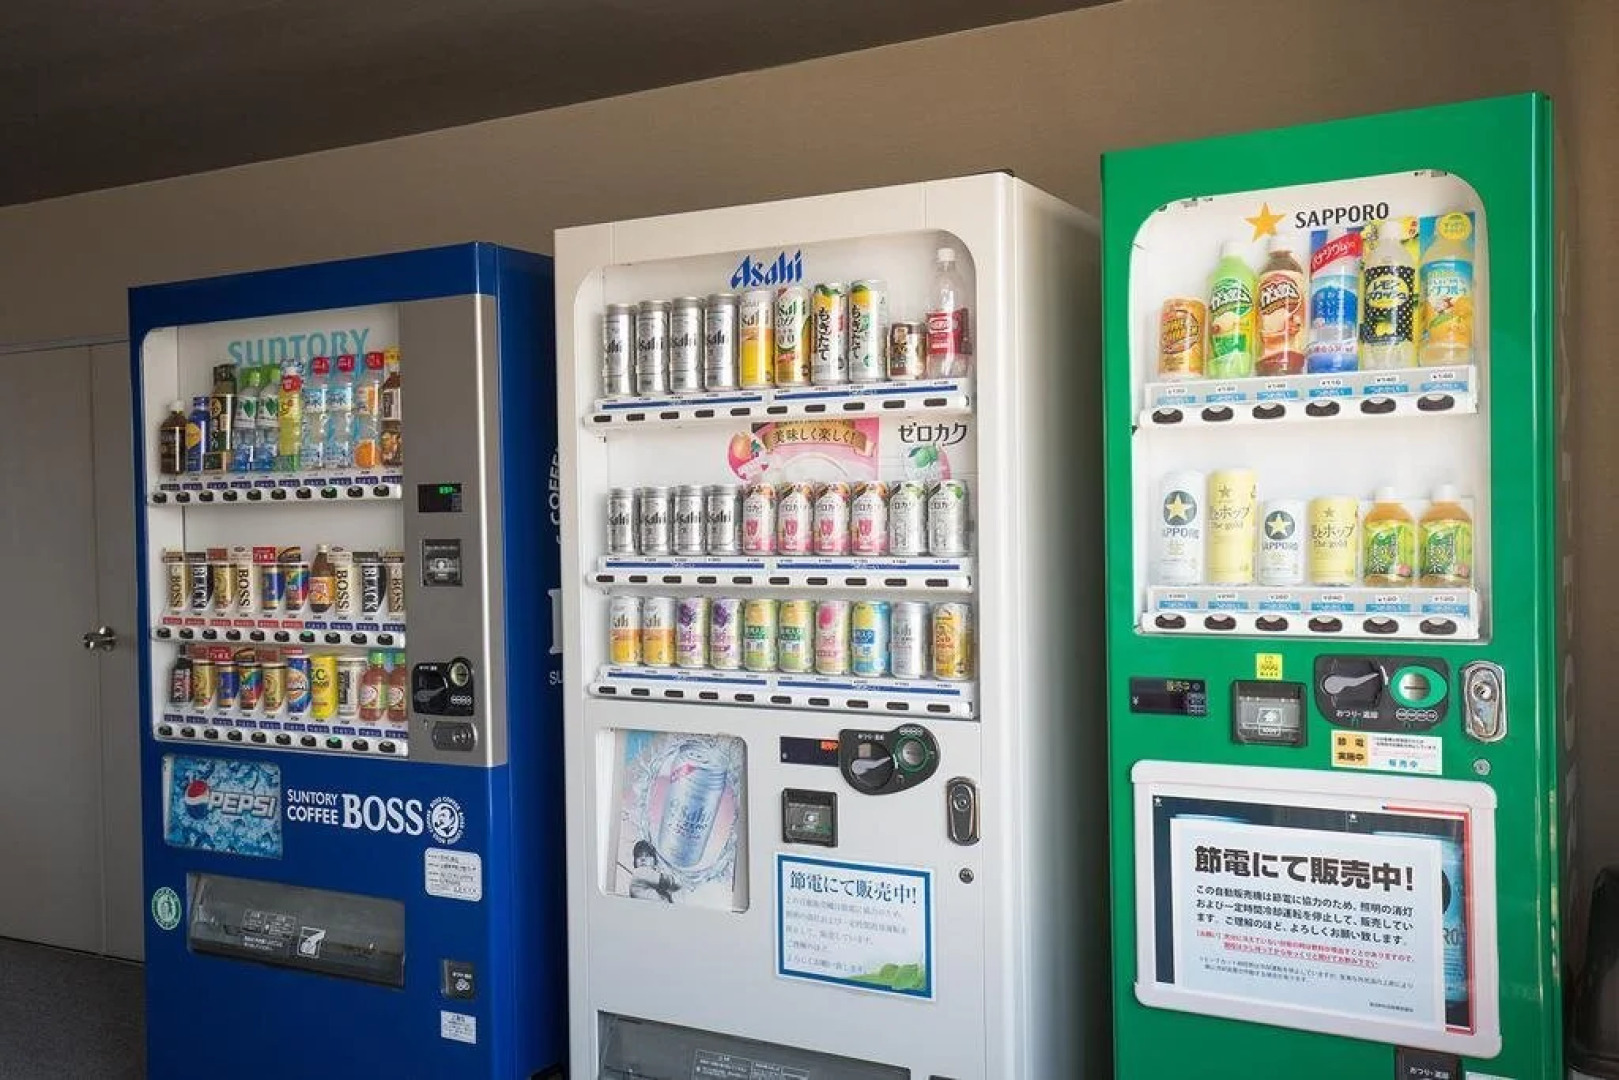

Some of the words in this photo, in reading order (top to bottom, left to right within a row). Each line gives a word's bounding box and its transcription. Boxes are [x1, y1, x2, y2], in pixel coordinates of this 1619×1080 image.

[1295, 202, 1389, 229] SAPPORO
[730, 250, 803, 290] Asahi
[898, 421, 968, 447] ゼロカク
[170, 575, 182, 608] BOSS
[238, 568, 251, 607] BOSS
[336, 570, 350, 610] BOSS
[211, 791, 278, 817] PEPSI
[287, 788, 338, 804] SUNTORY
[287, 805, 339, 825] COFFEE
[342, 793, 424, 836] BOSS
[1194, 845, 1414, 893] 節電にて販売中!
[790, 870, 918, 904] 節電にて販売中!
